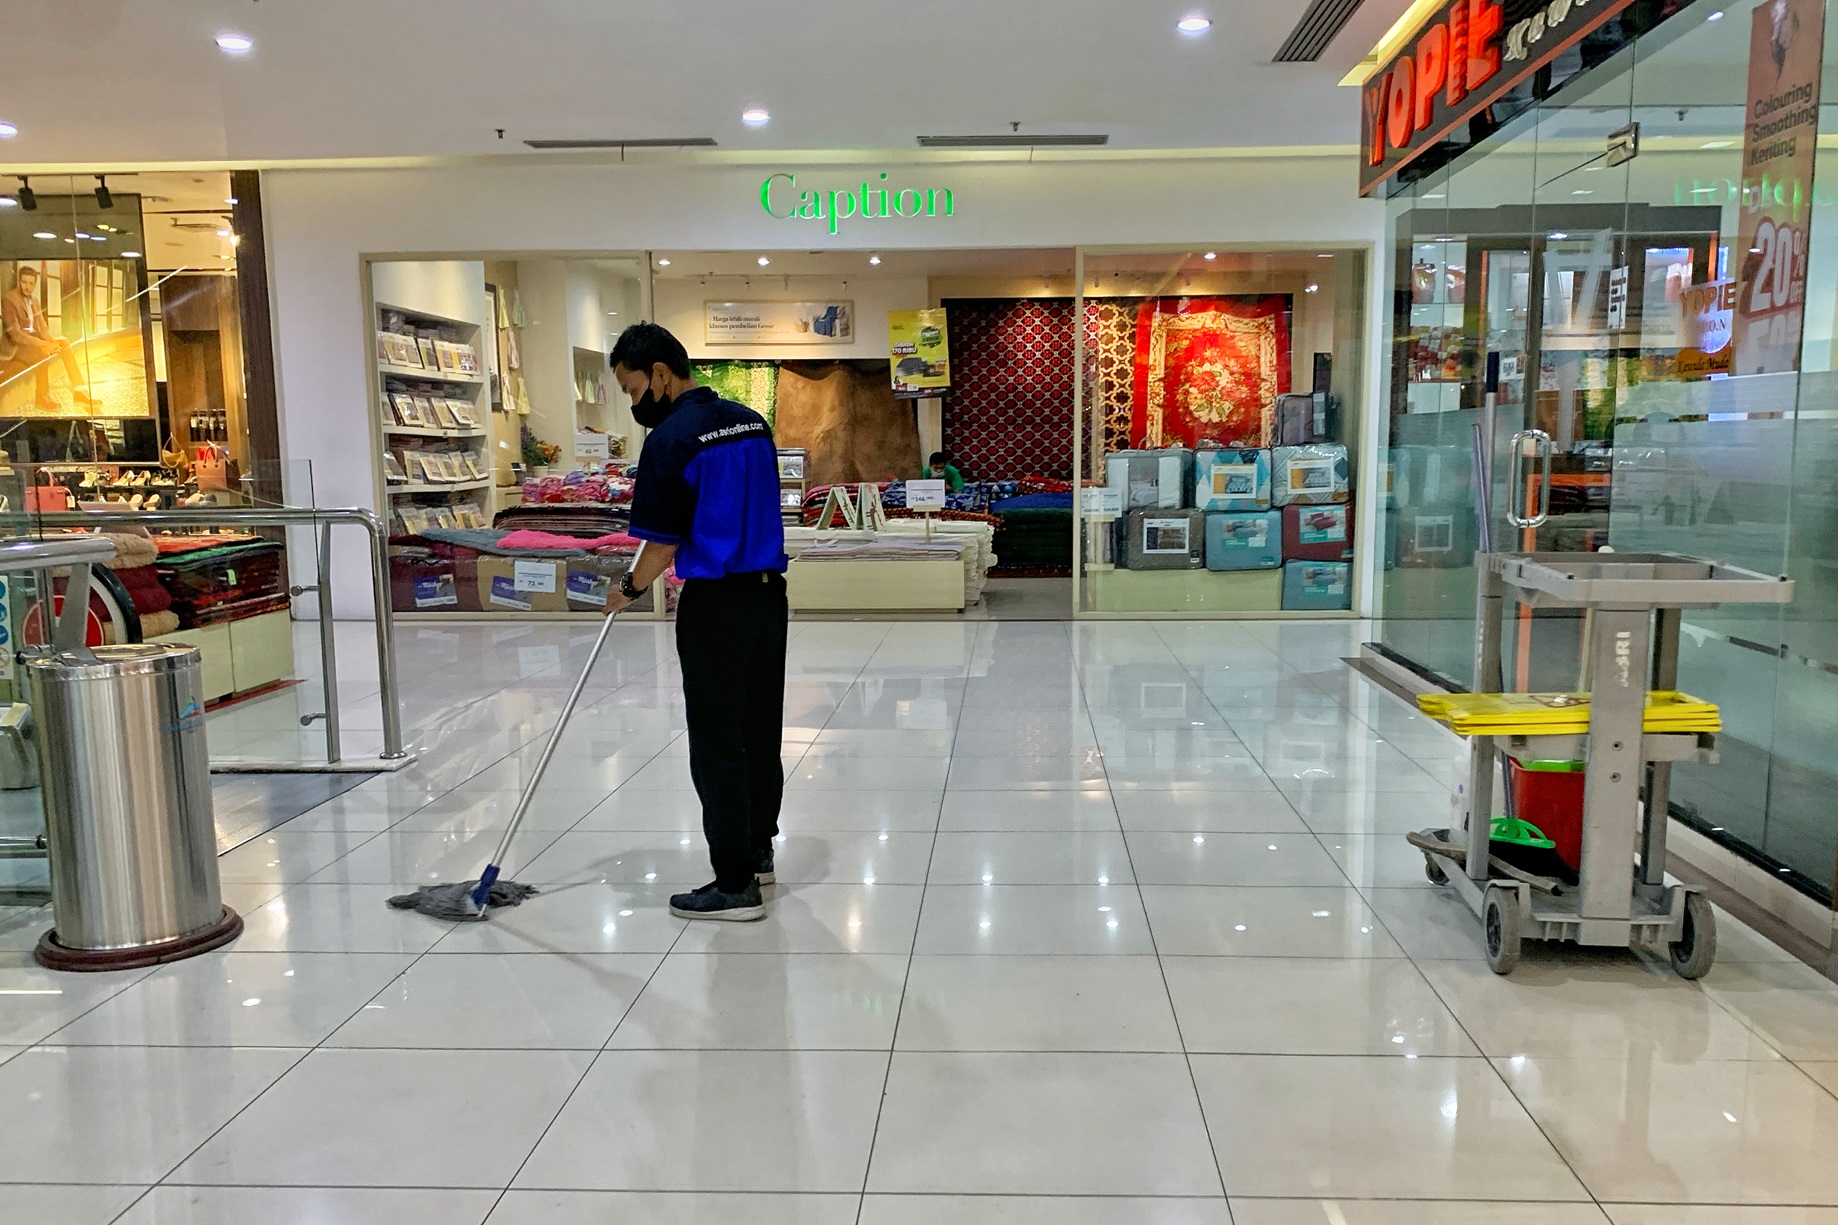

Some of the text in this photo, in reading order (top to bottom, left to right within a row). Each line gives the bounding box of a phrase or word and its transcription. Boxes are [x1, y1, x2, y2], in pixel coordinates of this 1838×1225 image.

[1365, 0, 1501, 167] YOPIE
[1753, 82, 1813, 119] Colouring
[1752, 103, 1818, 143] Smoothing
[1751, 137, 1797, 165] Keriting
[760, 173, 954, 235] Caption
[1680, 282, 1737, 318] YOPIE
[712, 315, 729, 323] Harga
[729, 322, 757, 331] pembelian
